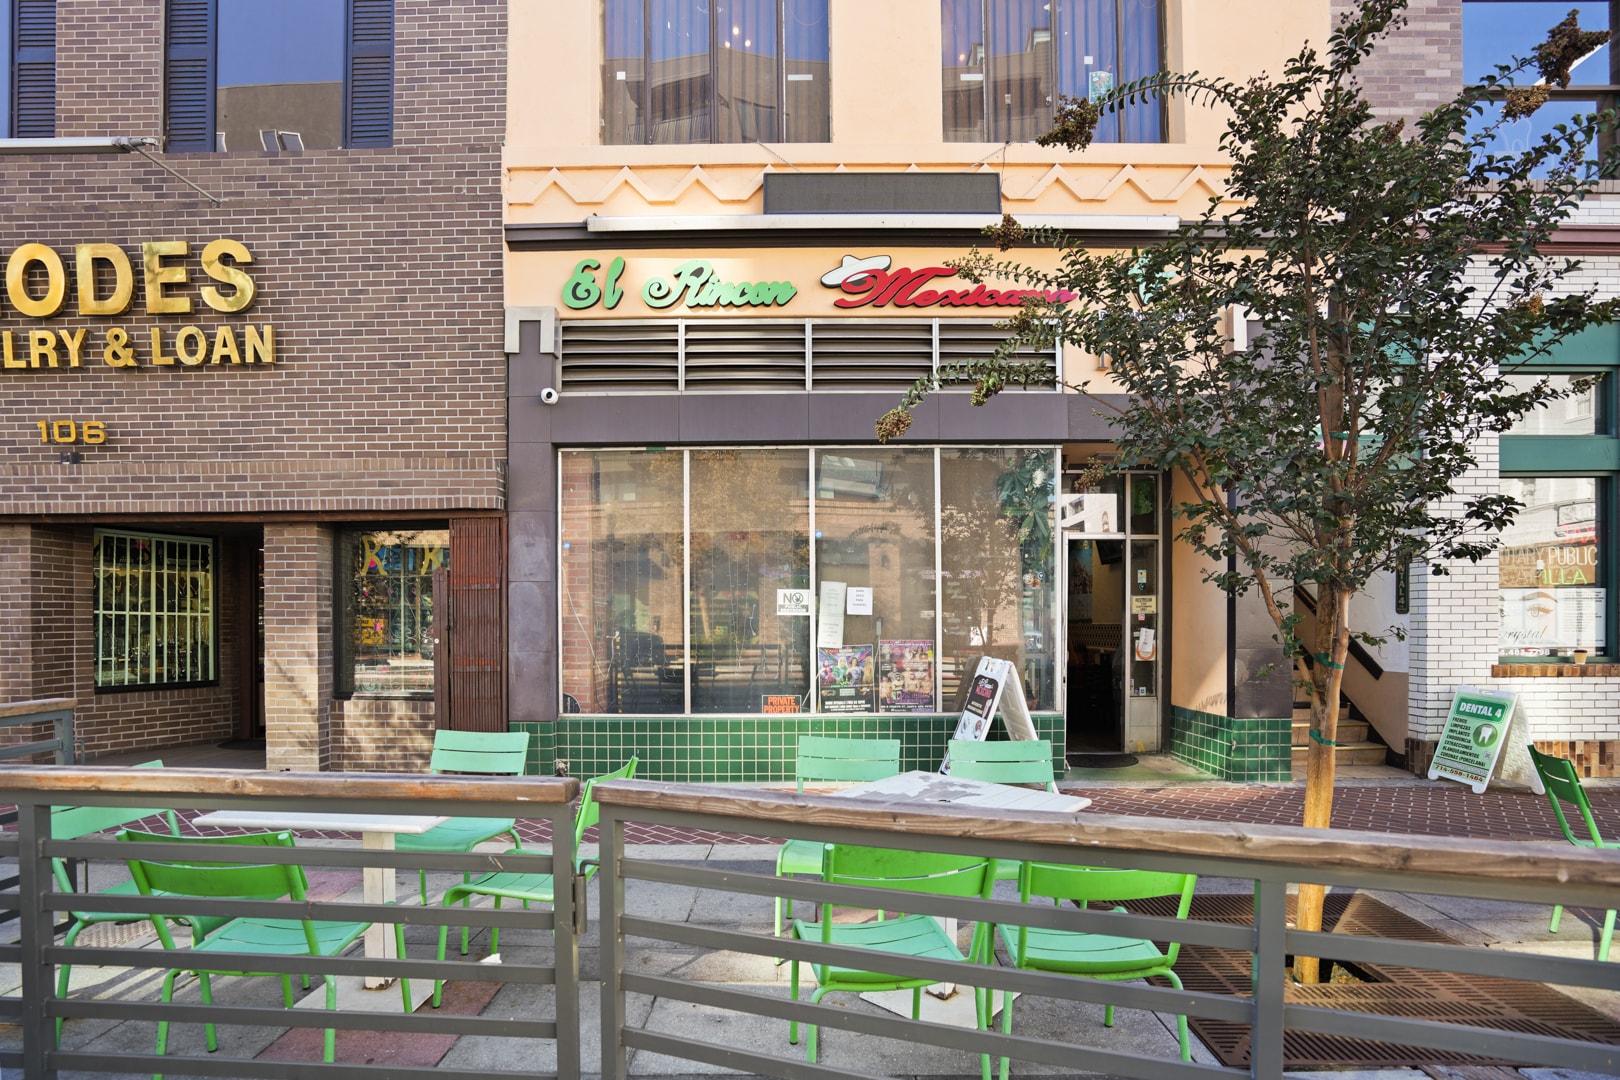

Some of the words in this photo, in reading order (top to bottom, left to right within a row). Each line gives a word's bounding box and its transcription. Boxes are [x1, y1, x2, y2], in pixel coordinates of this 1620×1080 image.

[562, 256, 625, 310] El
[642, 259, 797, 310] Rincon
[2, 328, 90, 369] LRY
[103, 326, 142, 367] &
[151, 325, 277, 366] LOAN
[36, 419, 108, 444] 106
[1548, 546, 1598, 566] PUBLIC
[764, 705, 800, 714] PROPERTY
[768, 696, 796, 706] PRIVATE
[1459, 702, 1493, 716] DENTAL
[1495, 708, 1502, 718] 4
